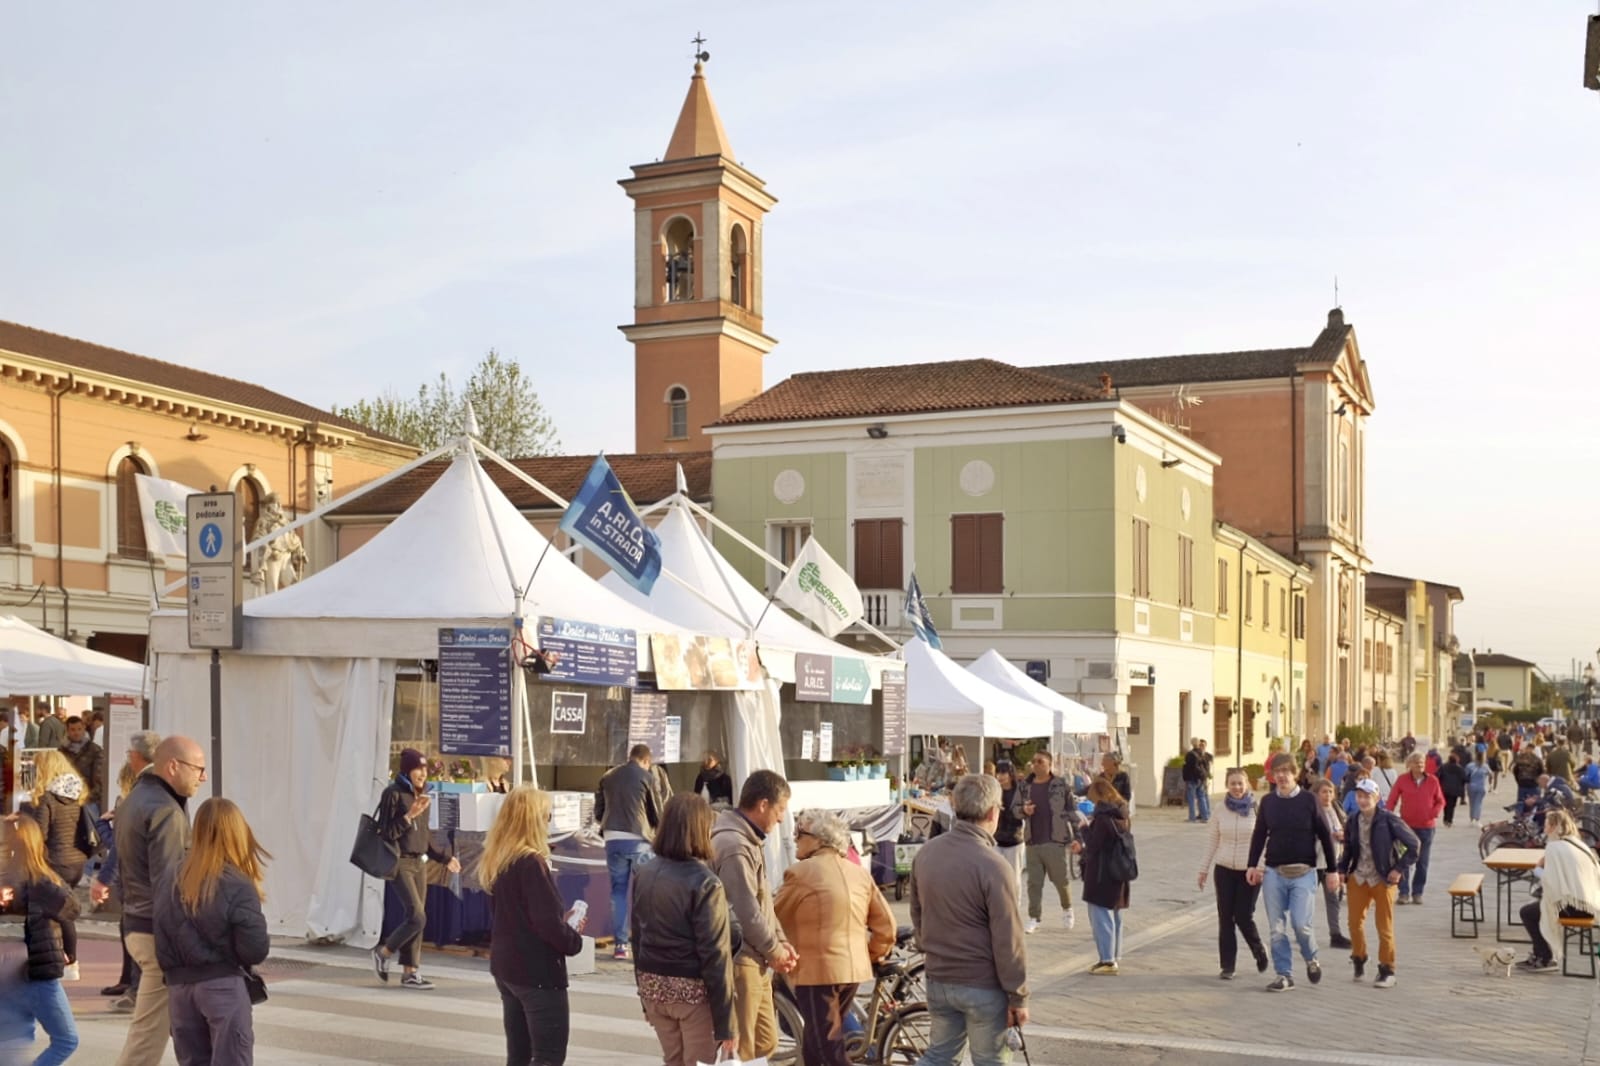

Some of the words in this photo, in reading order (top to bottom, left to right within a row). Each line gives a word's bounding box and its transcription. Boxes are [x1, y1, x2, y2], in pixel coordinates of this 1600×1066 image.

[195, 510, 226, 519] pedonale
[590, 513, 602, 529] in
[602, 524, 644, 565] STRADA
[459, 633, 477, 642] Dolci
[488, 634, 507, 643] Festa
[561, 621, 586, 637] Dolci
[598, 625, 620, 643] Festa
[554, 706, 583, 722] CASSA
